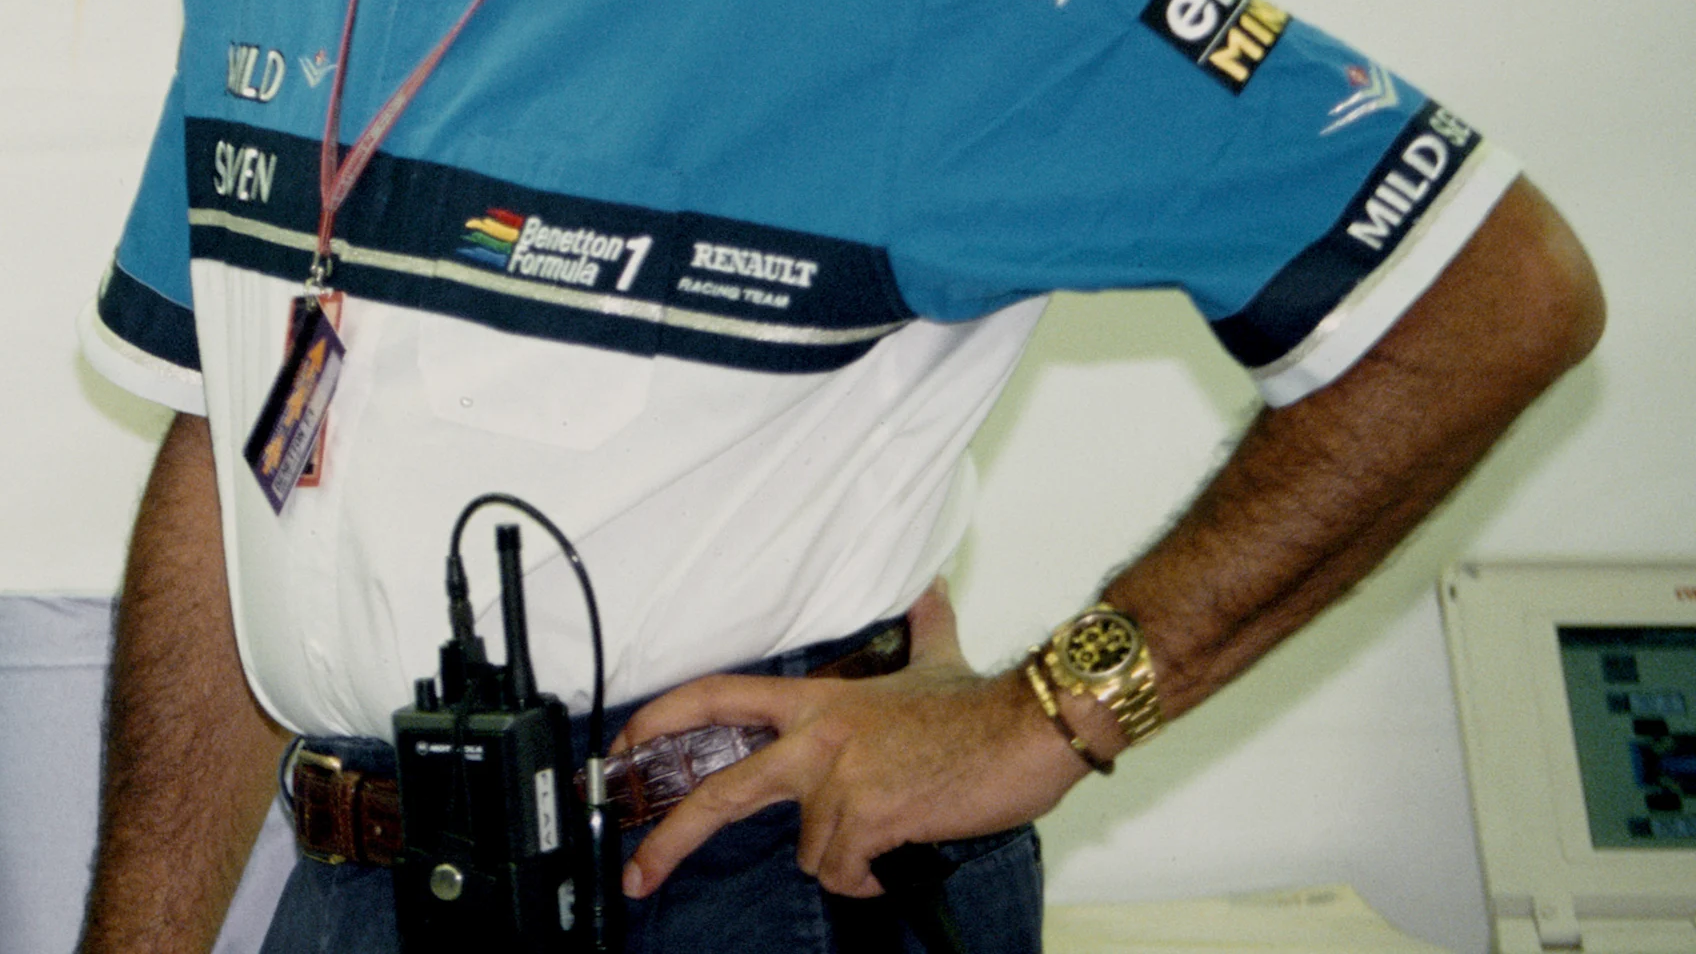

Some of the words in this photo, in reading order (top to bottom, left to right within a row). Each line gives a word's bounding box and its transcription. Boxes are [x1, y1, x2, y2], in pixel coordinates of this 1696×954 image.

[1346, 133, 1449, 251] MILD
[520, 216, 623, 261] Benetton
[508, 247, 600, 287] Formula
[616, 235, 652, 292] 1
[690, 242, 818, 288] RENAULT
[677, 276, 741, 303] RACING
[741, 287, 790, 310] TEAM
